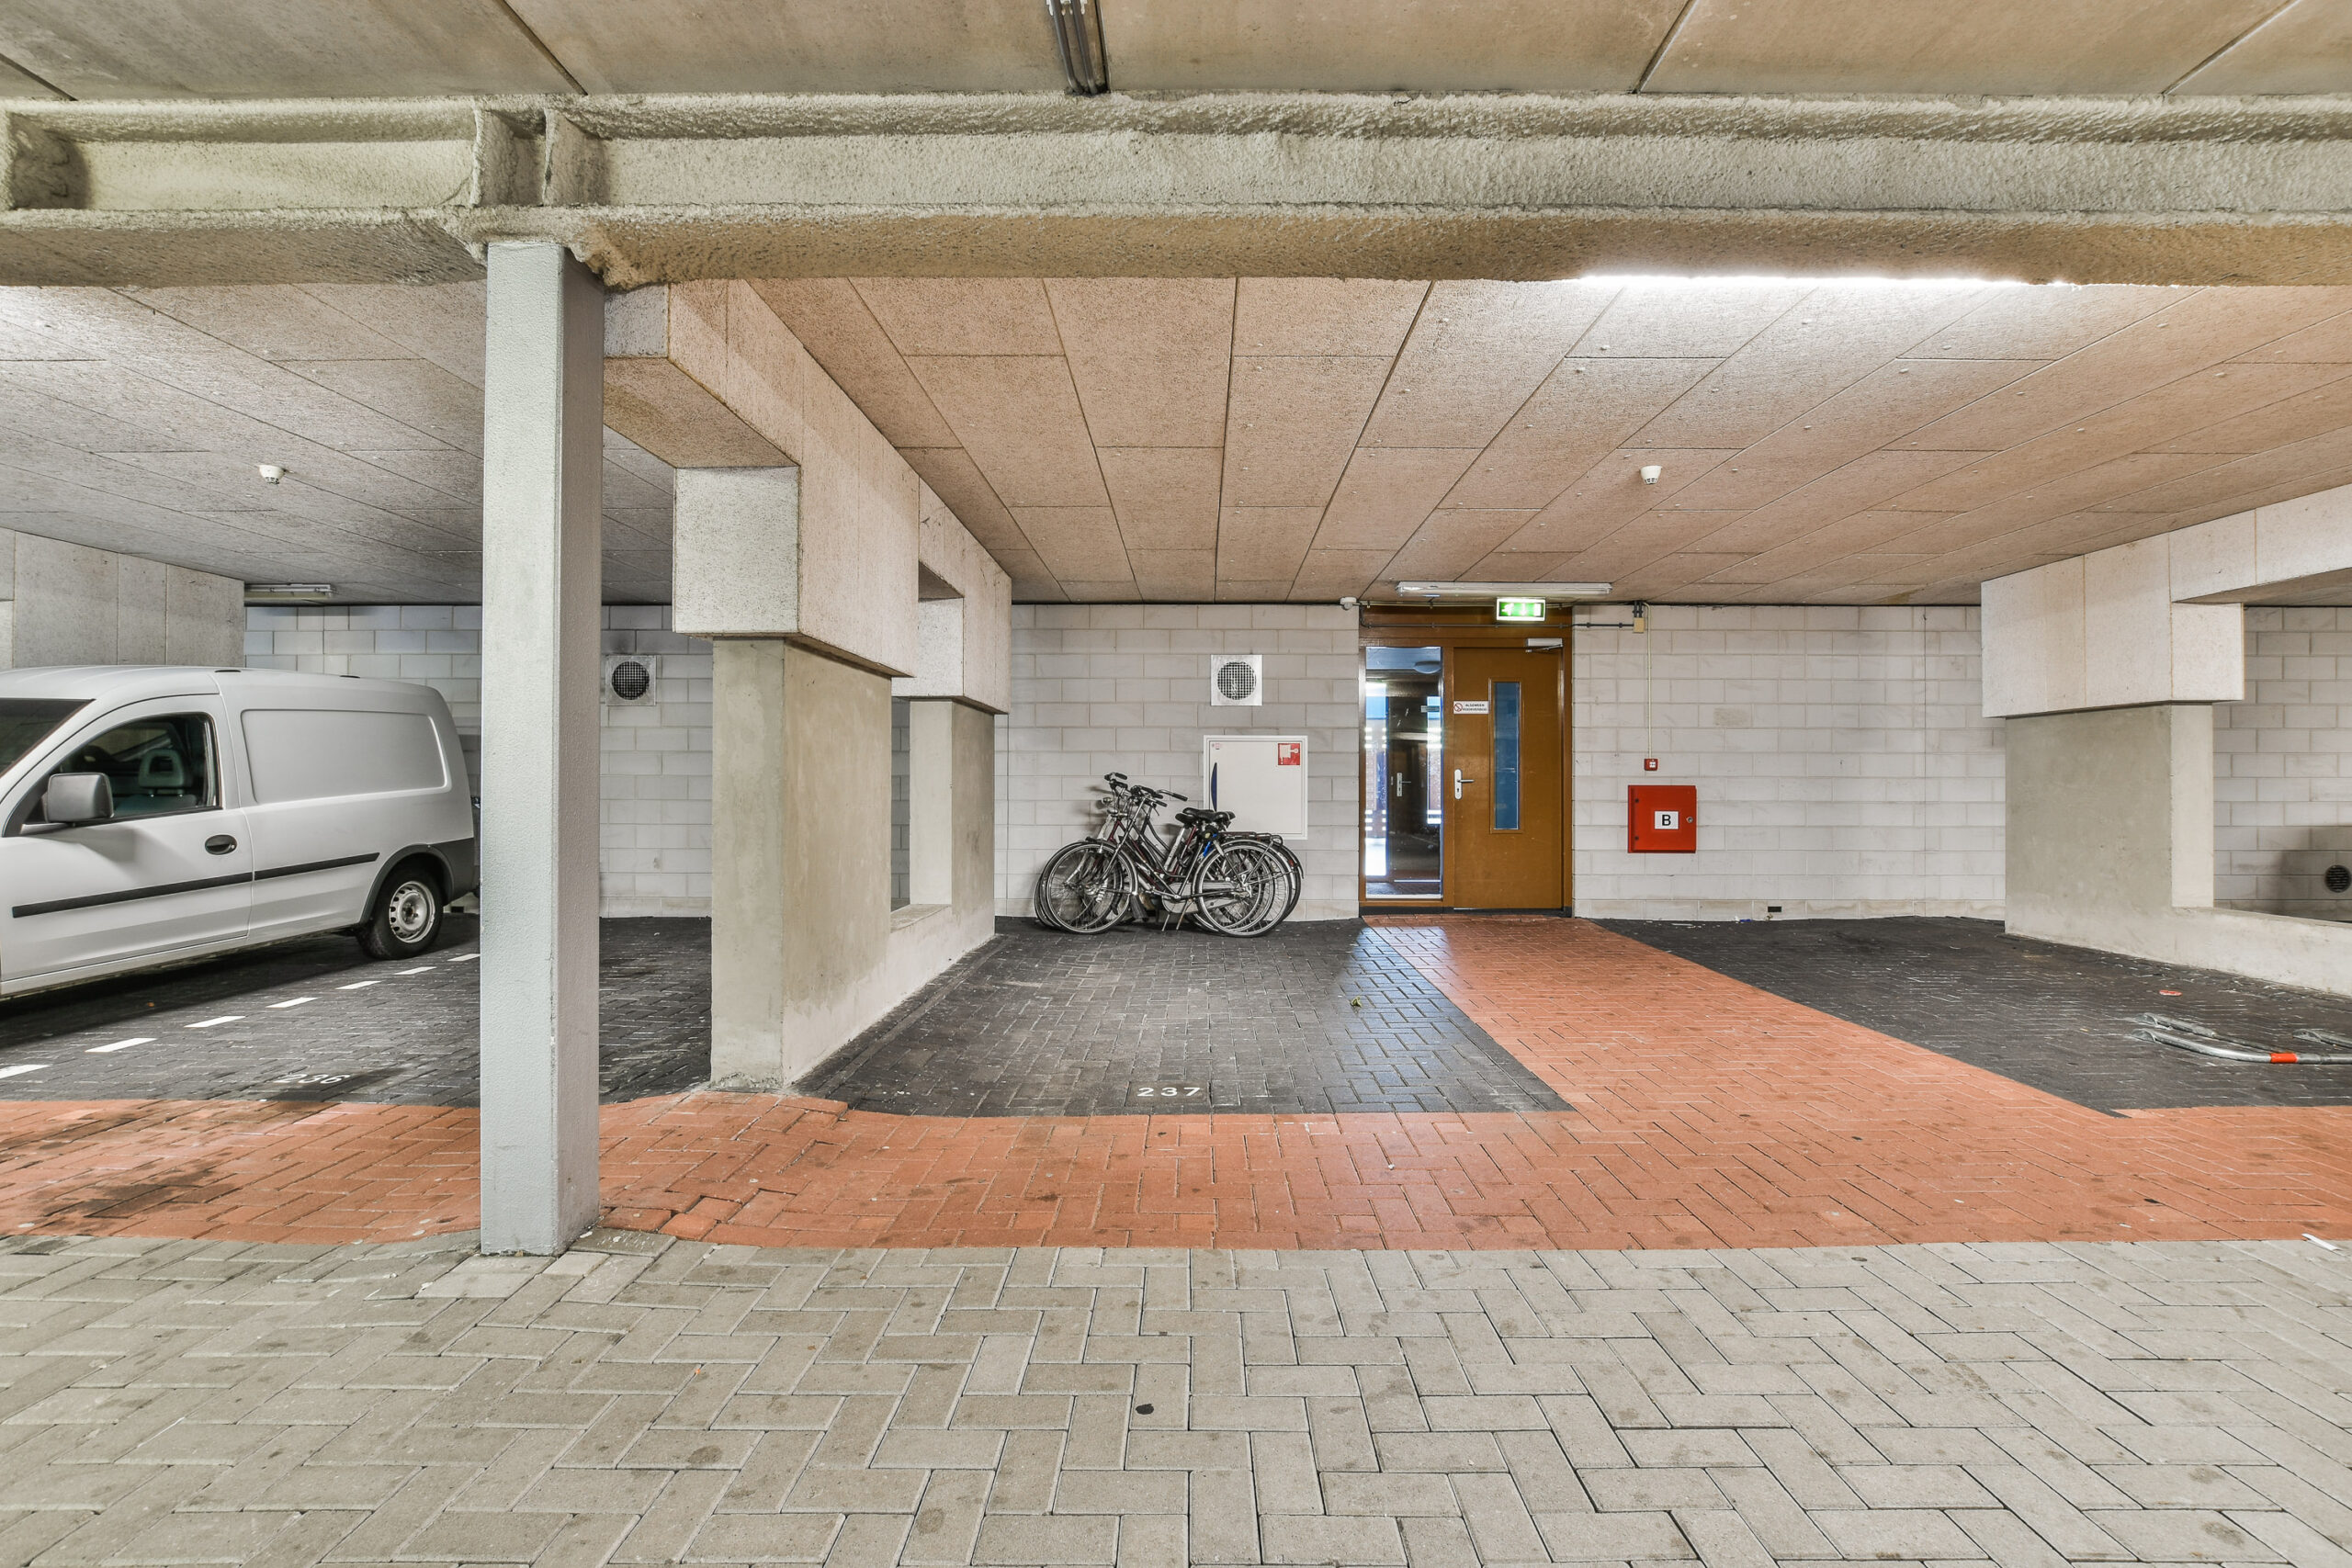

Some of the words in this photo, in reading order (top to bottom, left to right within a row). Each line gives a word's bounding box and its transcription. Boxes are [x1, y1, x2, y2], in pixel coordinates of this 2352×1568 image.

[1661, 814, 1671, 826] B
[273, 1074, 351, 1084] 236
[1136, 1087, 1201, 1097] 237
